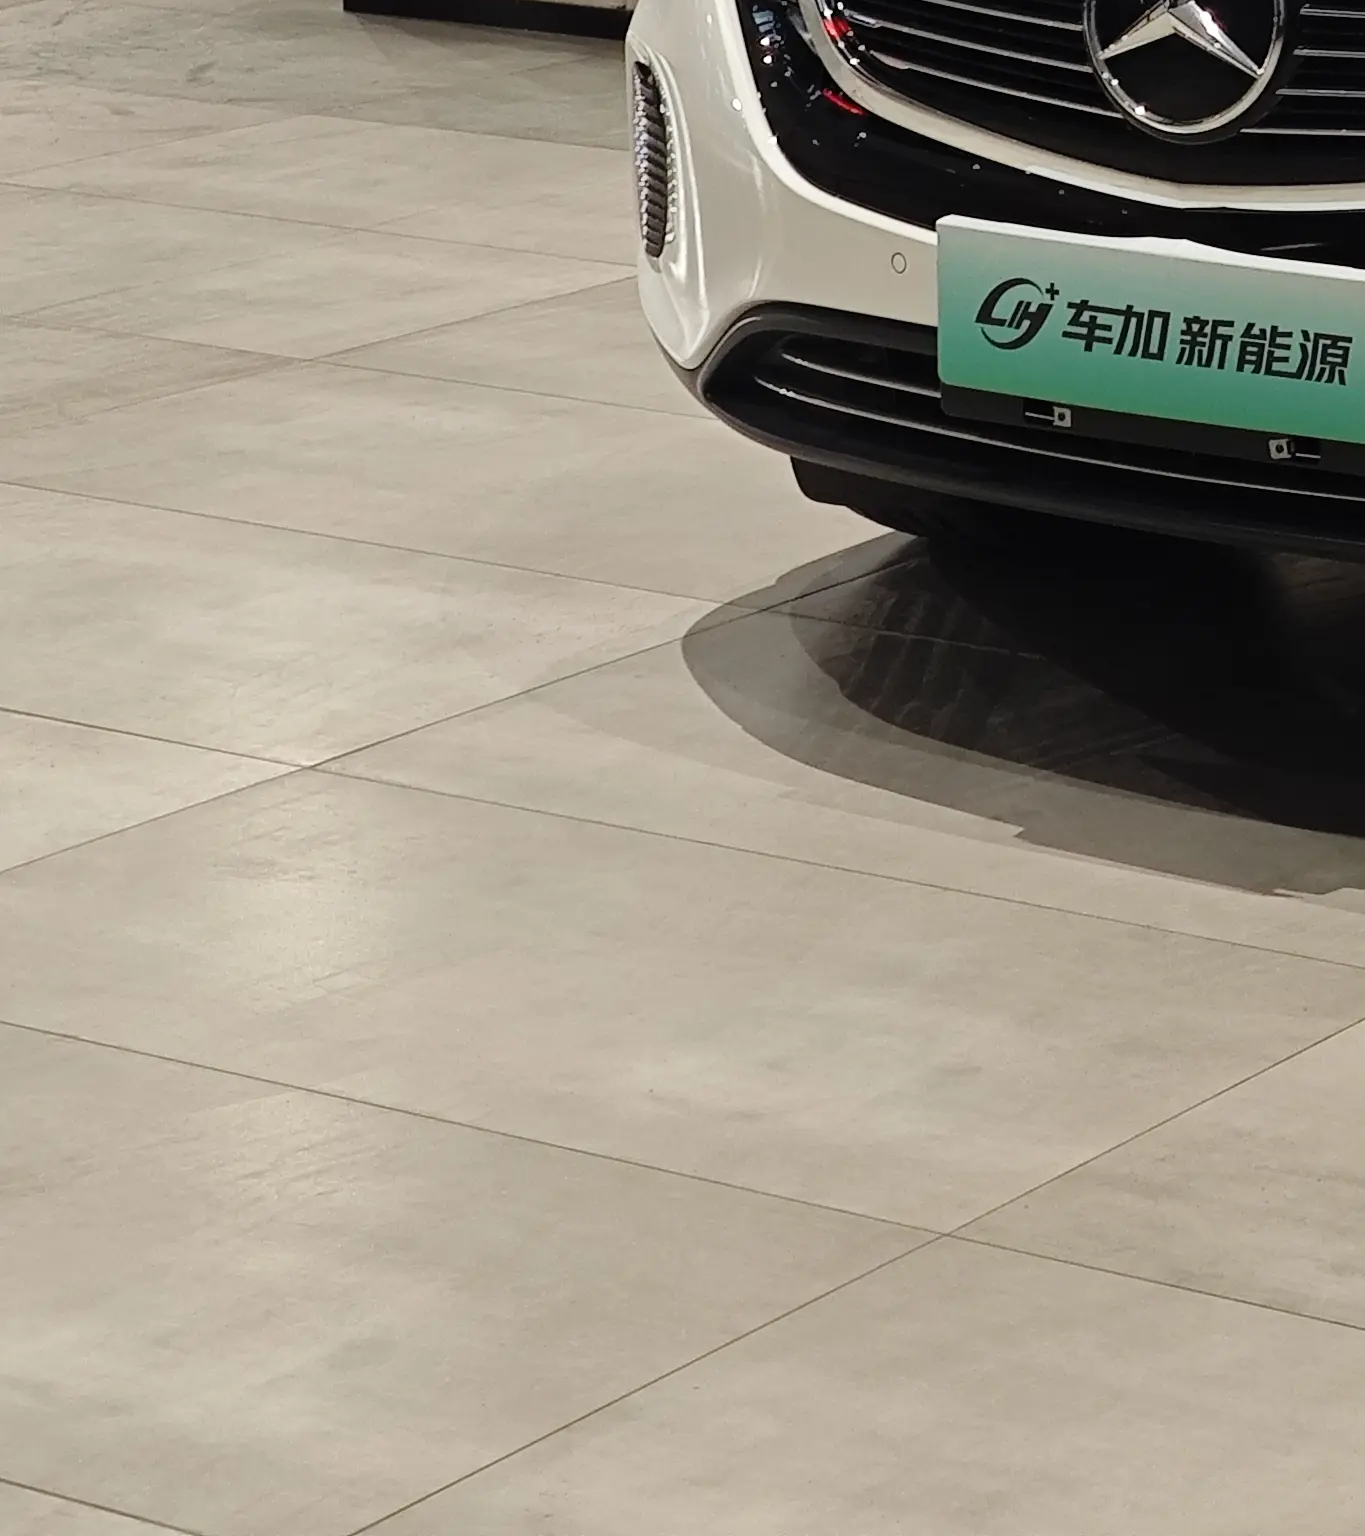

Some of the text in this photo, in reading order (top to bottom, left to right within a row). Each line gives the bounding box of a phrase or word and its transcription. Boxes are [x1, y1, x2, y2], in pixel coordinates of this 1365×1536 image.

[1061, 299, 1353, 386] 车加新能源
